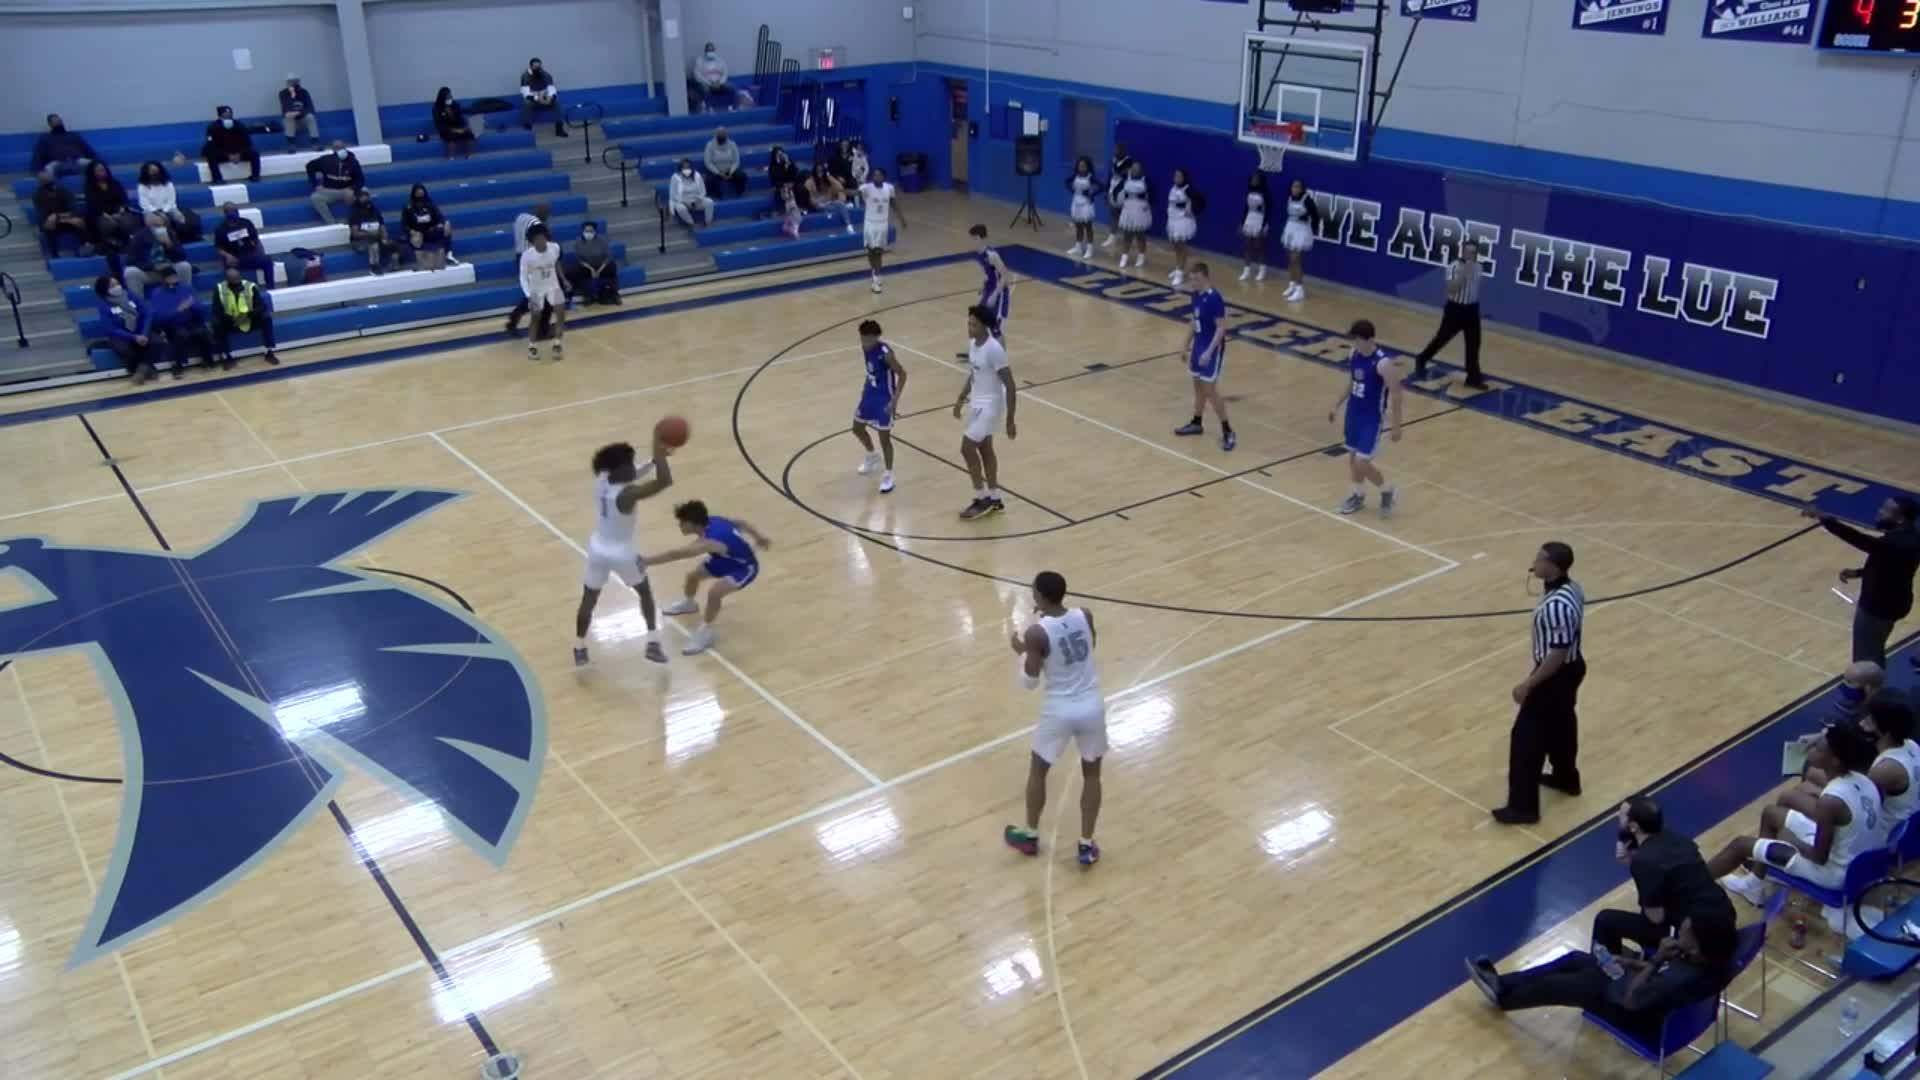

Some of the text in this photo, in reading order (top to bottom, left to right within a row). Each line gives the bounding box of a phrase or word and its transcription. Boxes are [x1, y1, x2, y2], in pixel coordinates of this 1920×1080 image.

[1607, 2, 1659, 18] JENNINGS
[1738, 8, 1801, 26] WILLIAMS
[1857, 0, 1875, 24] 4
[1900, 0, 1920, 28] 3
[1642, 17, 1657, 30] #1
[1305, 189, 1779, 339] WE ARE THE LUE
[1059, 271, 1872, 503] LUTERN EAST
[1059, 630, 1089, 665] 15
